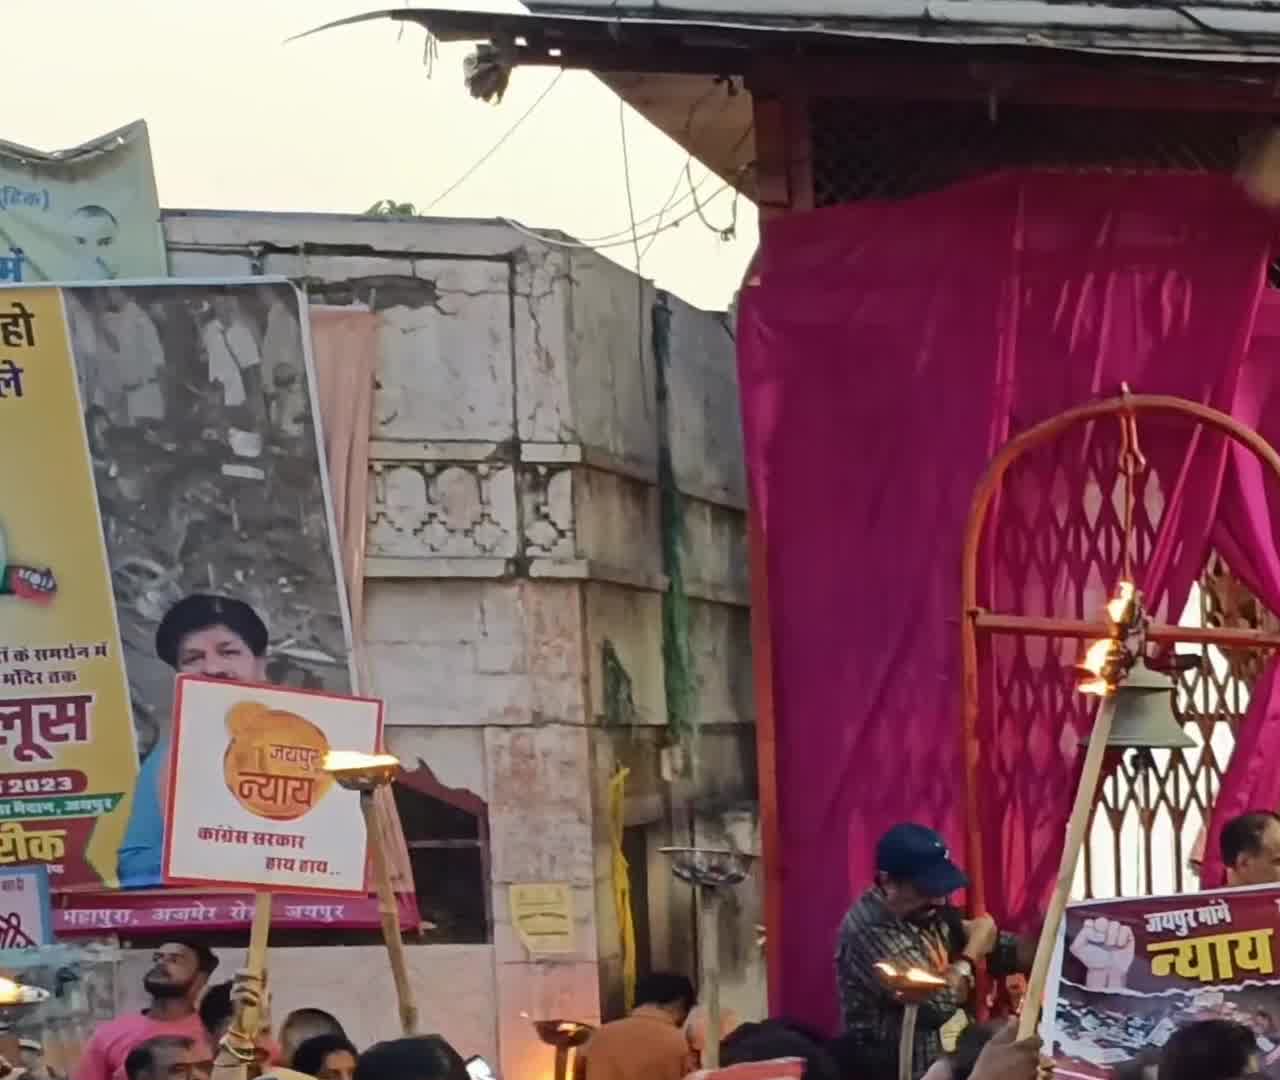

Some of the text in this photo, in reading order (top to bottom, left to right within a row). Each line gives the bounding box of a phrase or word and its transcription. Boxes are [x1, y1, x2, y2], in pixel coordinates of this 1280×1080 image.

[32, 643, 89, 662] समर्थन
[48, 670, 77, 685] तक
[8, 776, 72, 794] 2023
[238, 771, 316, 807] न्याय
[197, 824, 306, 850] कांग्रेस सरकार
[265, 856, 295, 872] हाय
[152, 902, 216, 922] अजमेर
[284, 904, 345, 922] जयपुर
[1144, 909, 1198, 938] जयपुर
[1146, 928, 1275, 983] न्याय
